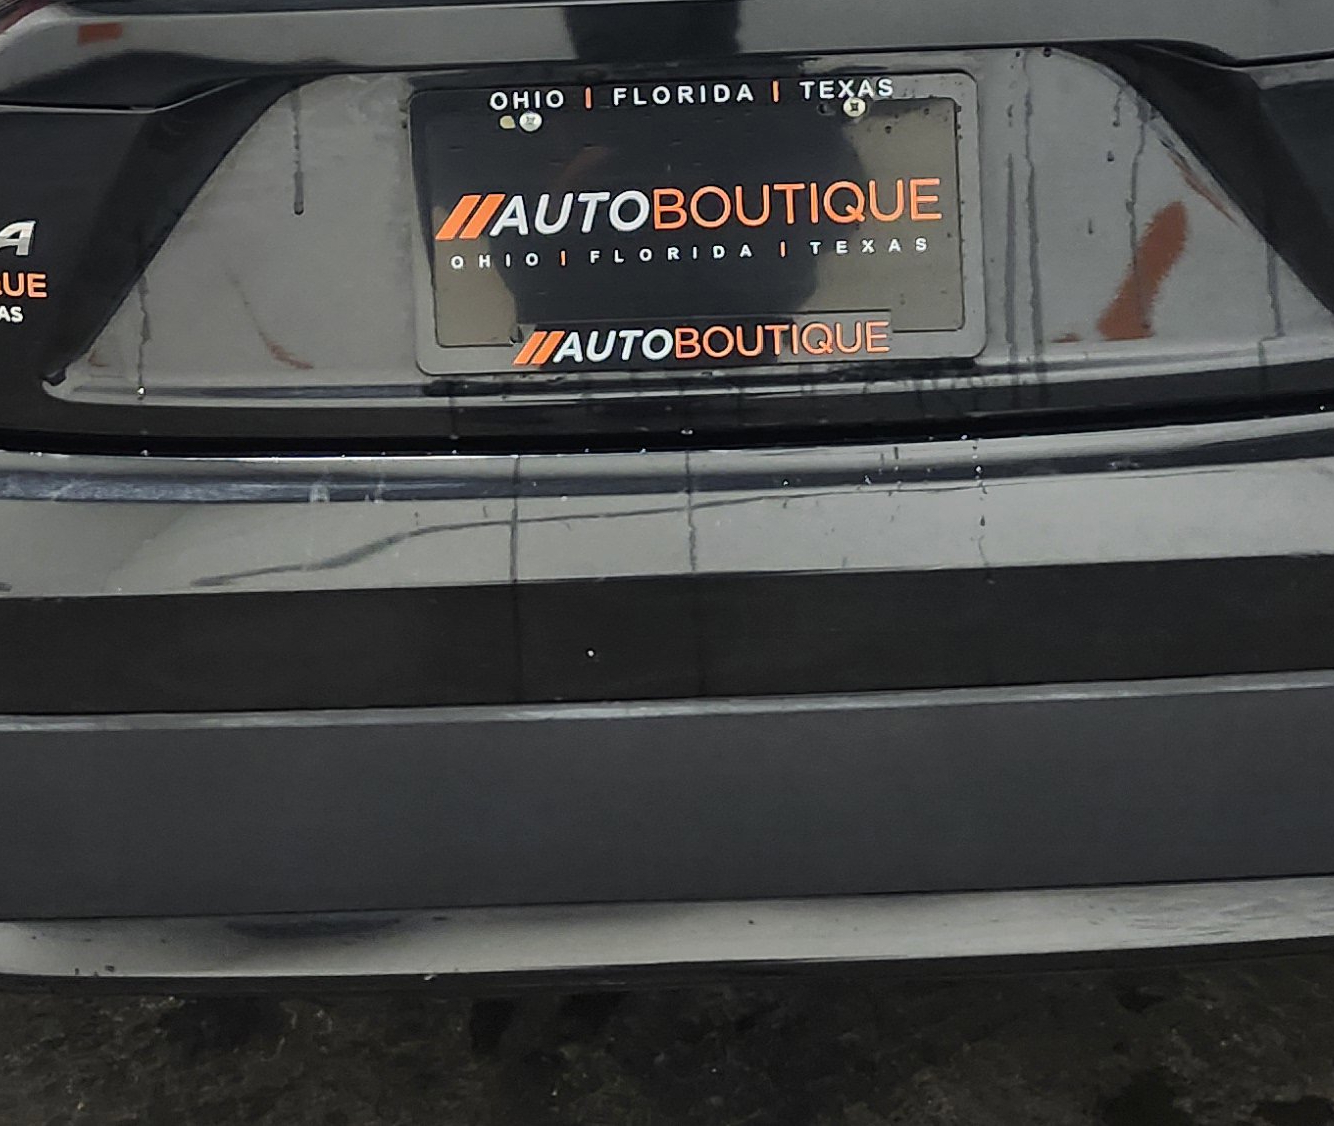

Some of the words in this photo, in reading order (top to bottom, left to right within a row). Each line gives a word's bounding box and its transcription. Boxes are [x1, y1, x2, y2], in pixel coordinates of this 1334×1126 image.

[489, 88, 565, 112] OHIO
[612, 83, 754, 107] FLORIDA
[799, 78, 894, 100] TEXAS
[490, 178, 942, 236] AUTOBOUTIQUE
[450, 253, 540, 270] OHIO
[589, 244, 753, 264] FLORIDA
[810, 237, 929, 255] TEXAS
[552, 321, 892, 363] AUTOBOUTIQUE
